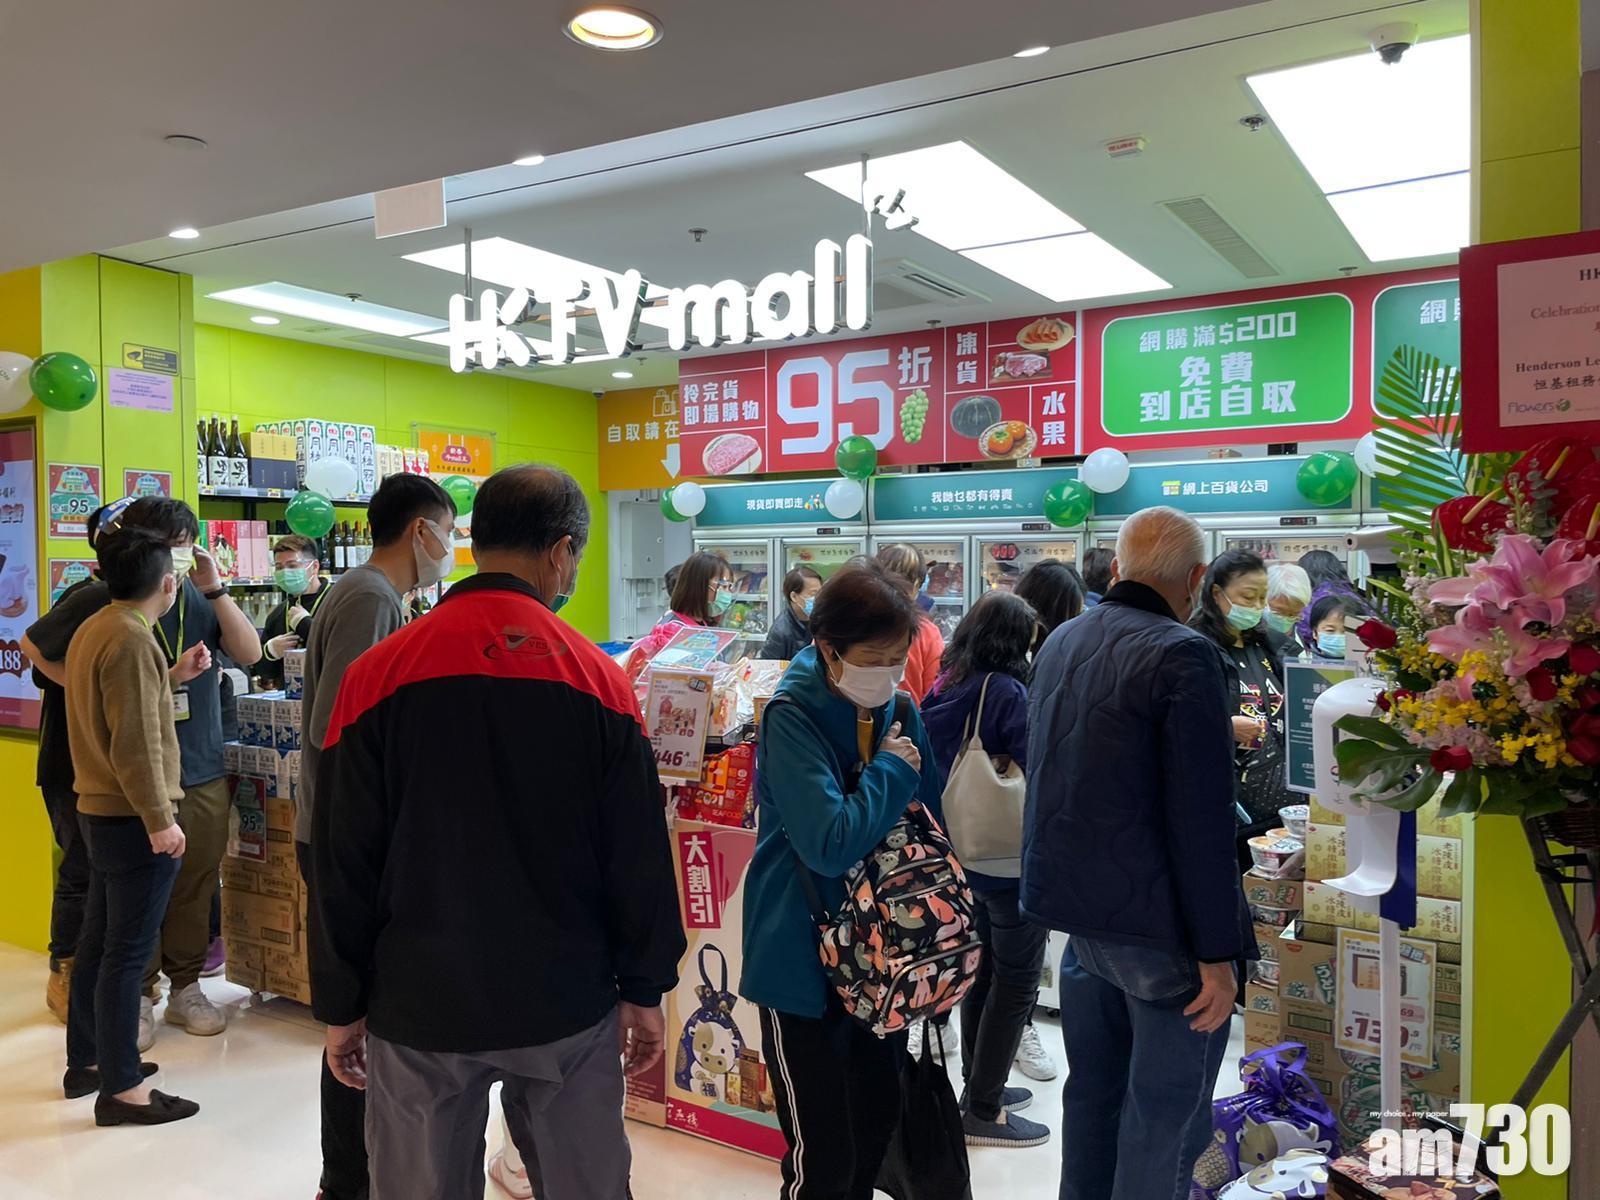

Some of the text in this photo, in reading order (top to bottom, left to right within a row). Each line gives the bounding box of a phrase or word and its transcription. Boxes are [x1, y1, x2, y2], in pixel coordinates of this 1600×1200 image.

[1420, 297, 1459, 325] 網
[1179, 351, 1254, 388] 免費
[1515, 356, 1600, 373] Henderson Le
[683, 380, 739, 404] 拎完貨
[1139, 380, 1298, 422] 到店自取
[607, 419, 679, 443] 自取請在
[1042, 390, 1066, 446] 水果
[1182, 479, 1269, 496] 網上百貨公司
[684, 834, 715, 923] 大割引
